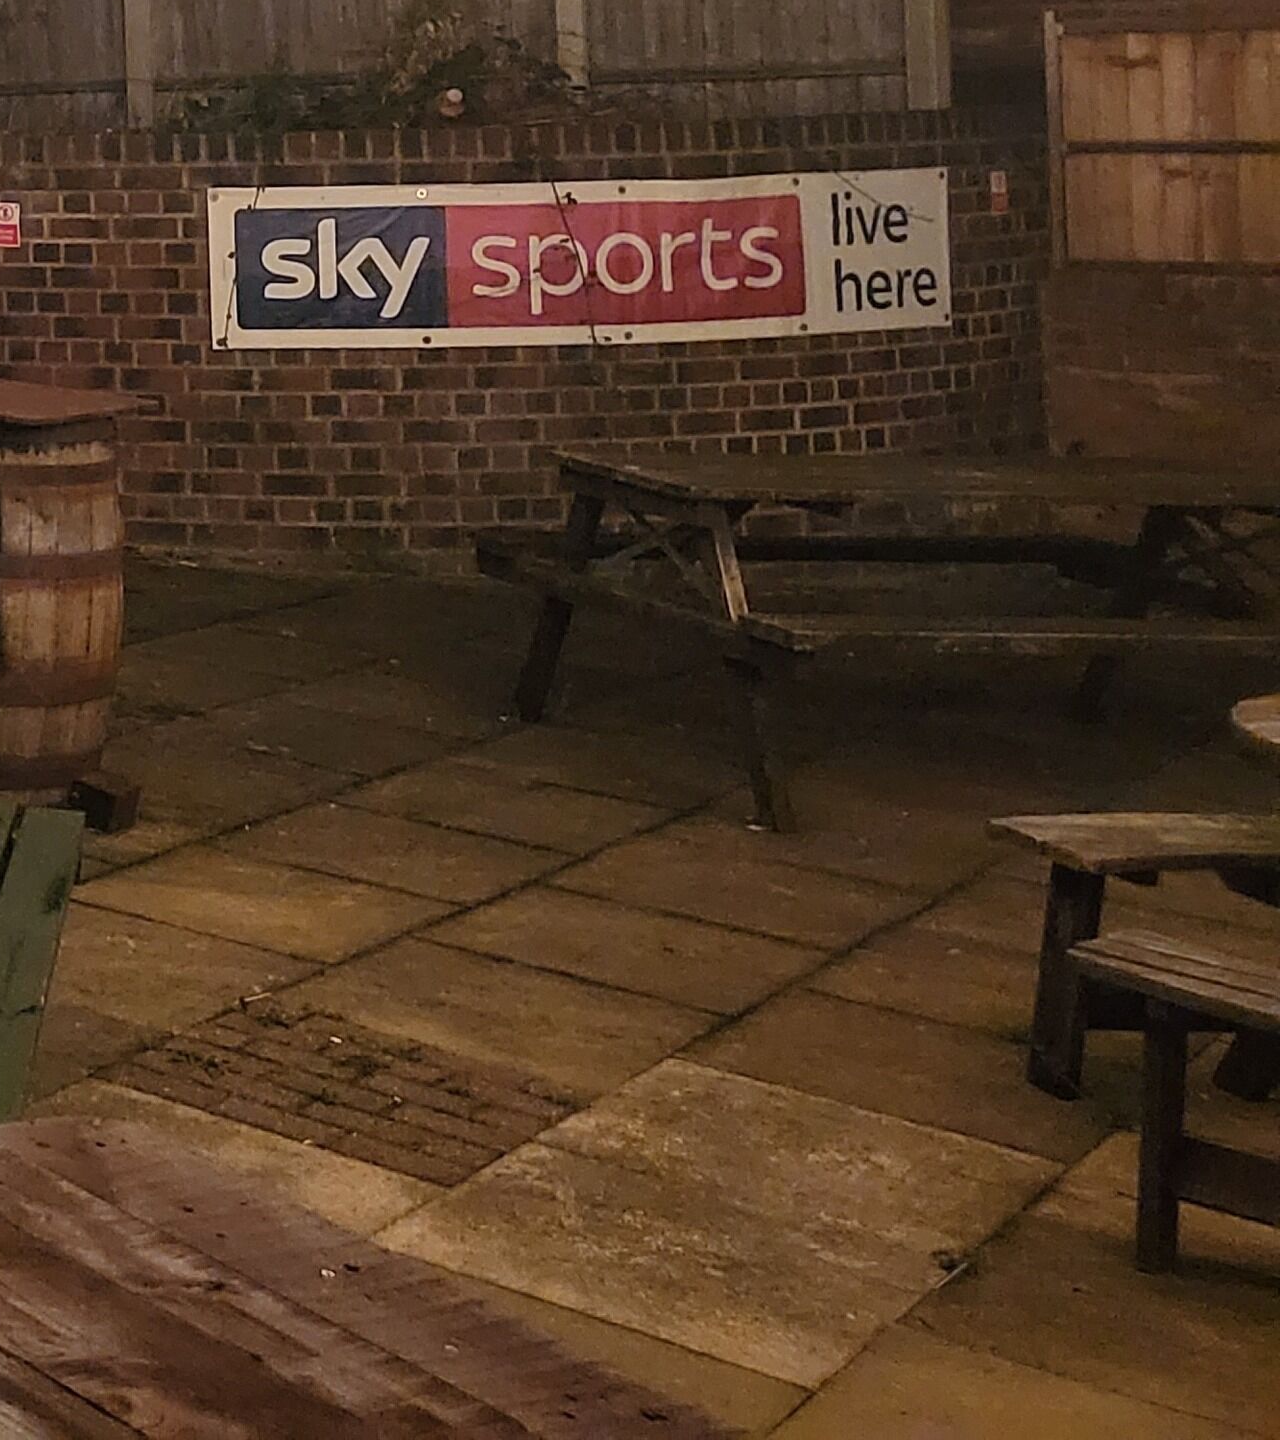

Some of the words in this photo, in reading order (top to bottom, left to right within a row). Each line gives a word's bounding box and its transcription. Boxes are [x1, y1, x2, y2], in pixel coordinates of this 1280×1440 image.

[831, 191, 909, 247] live
[261, 217, 431, 319] sky
[471, 218, 784, 316] sports
[834, 258, 938, 313] here
